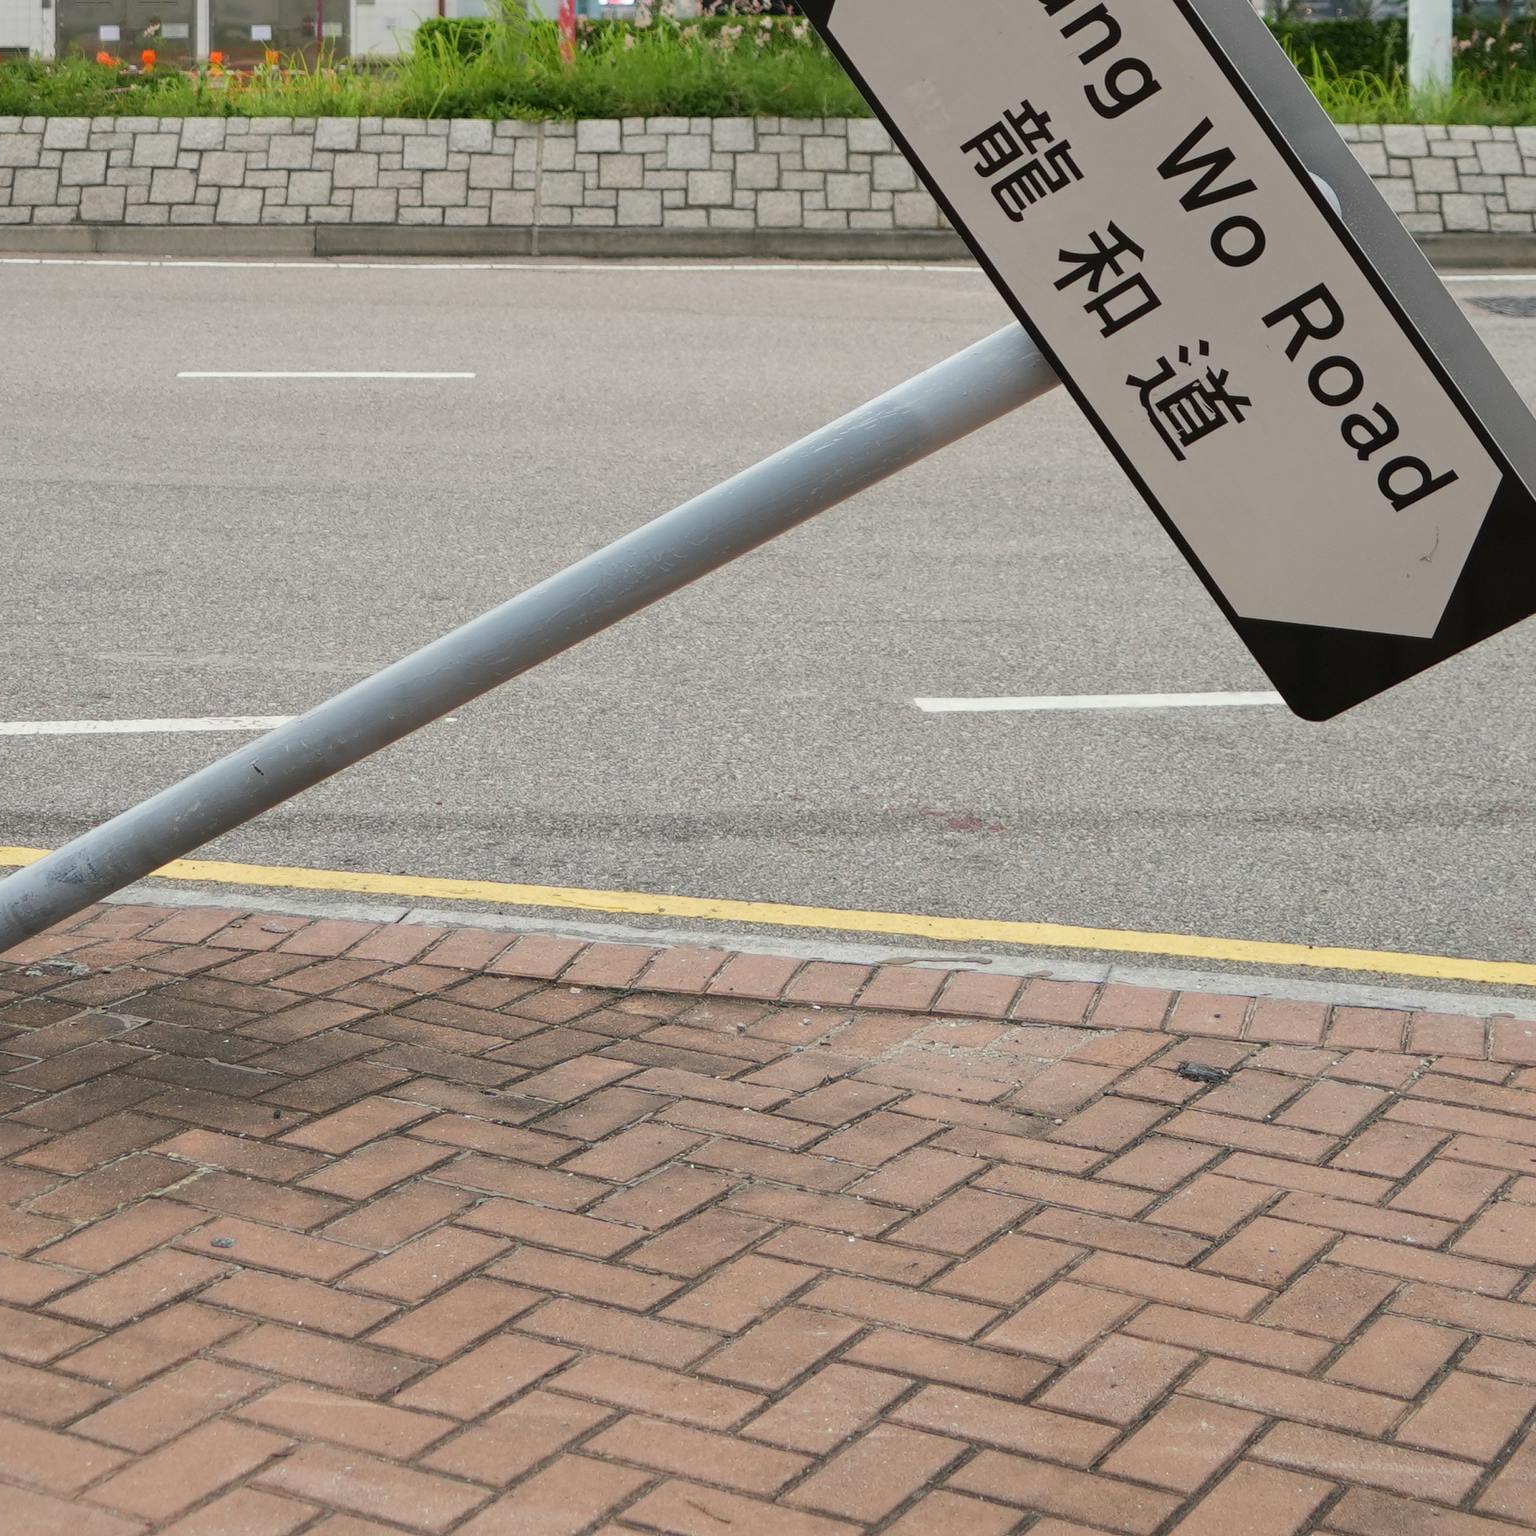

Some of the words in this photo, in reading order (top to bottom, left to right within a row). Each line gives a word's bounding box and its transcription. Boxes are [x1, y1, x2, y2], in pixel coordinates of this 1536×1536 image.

[959, 98, 1253, 462] 龍和道
[1156, 116, 1266, 268] Wo
[1261, 282, 1460, 513] Road
